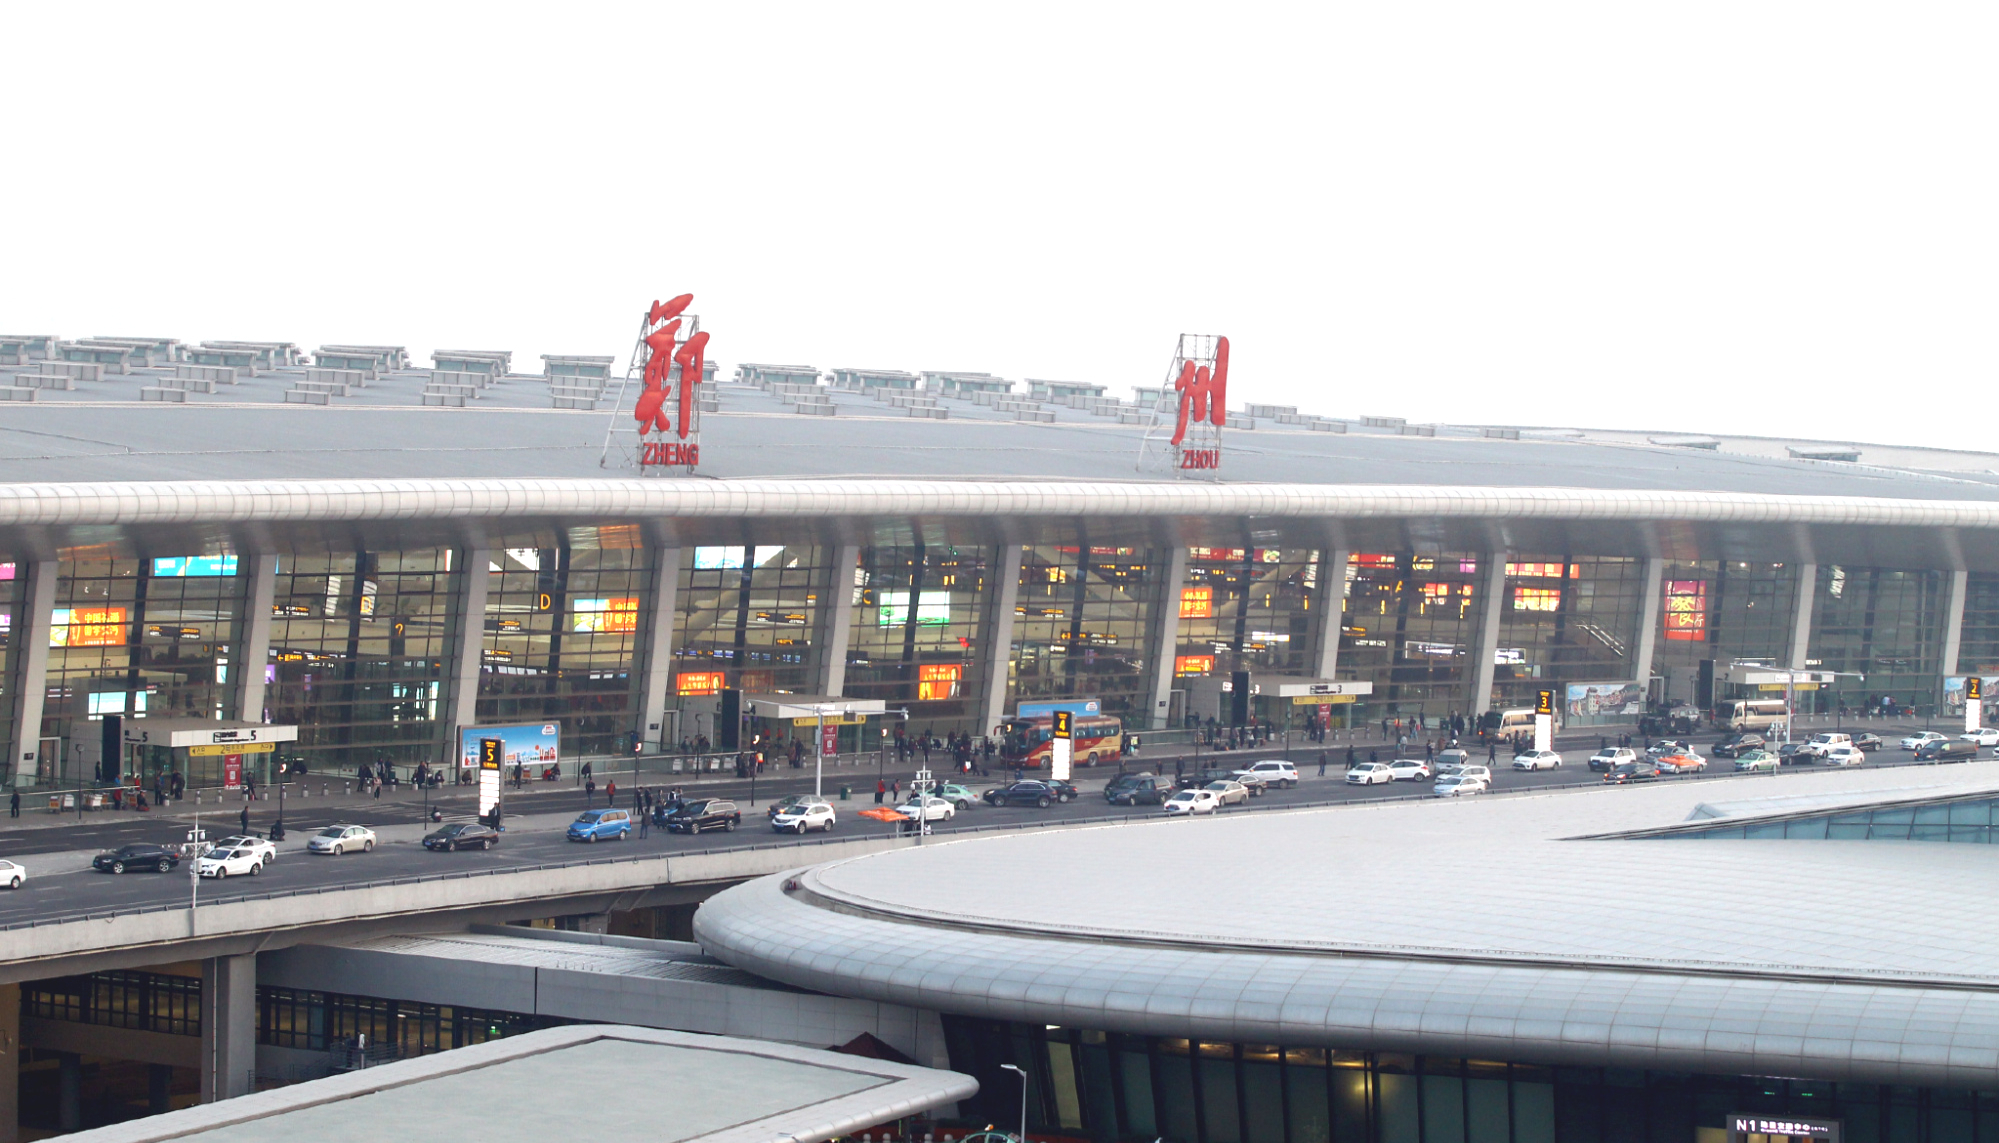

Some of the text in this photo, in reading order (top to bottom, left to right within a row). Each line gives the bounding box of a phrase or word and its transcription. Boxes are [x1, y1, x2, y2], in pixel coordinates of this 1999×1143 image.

[642, 442, 699, 466] ZHENG
[1180, 449, 1220, 470] ZHOU
[360, 596, 372, 613] D
[540, 593, 551, 610] D
[1337, 684, 1342, 694] 3
[1971, 682, 1978, 694] 2
[1541, 696, 1548, 708] 3
[1058, 719, 1066, 731] 4
[142, 731, 148, 742] 5
[250, 730, 256, 741] 5
[487, 748, 494, 762] 5
[1736, 1118, 1756, 1132] N1
